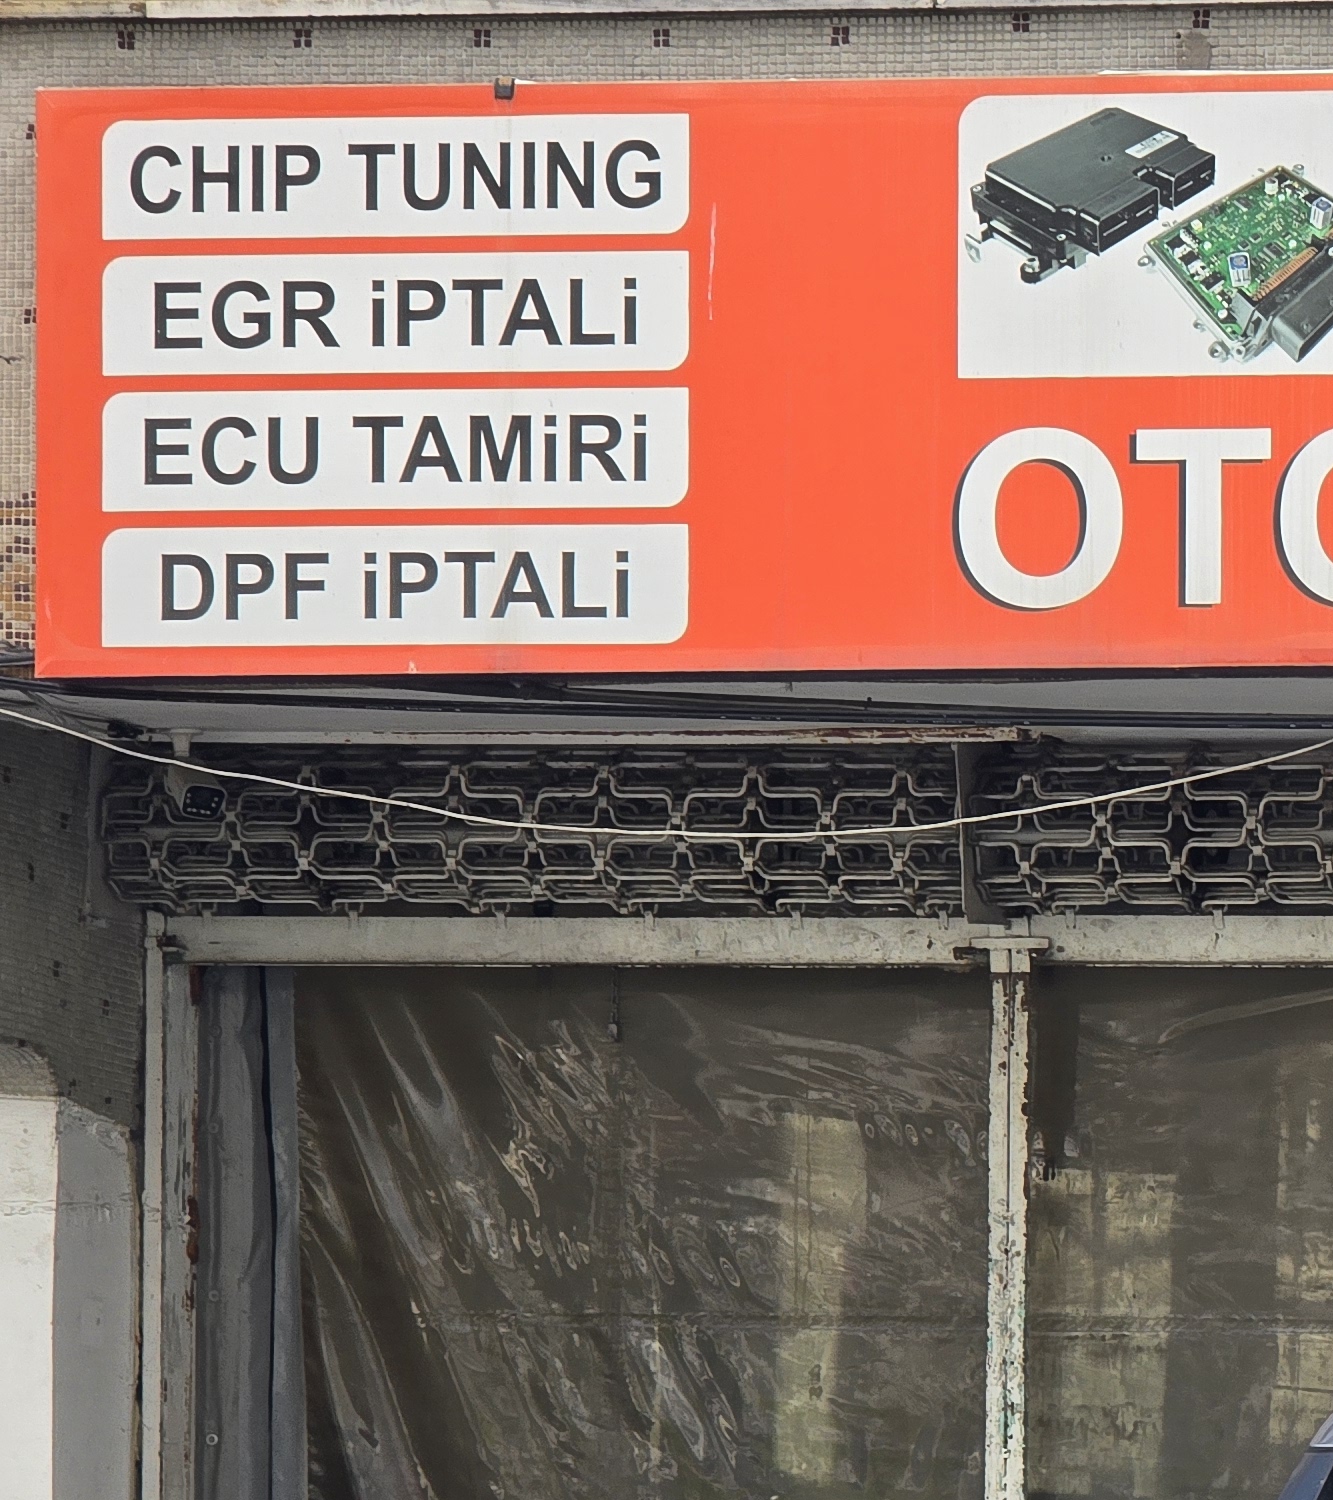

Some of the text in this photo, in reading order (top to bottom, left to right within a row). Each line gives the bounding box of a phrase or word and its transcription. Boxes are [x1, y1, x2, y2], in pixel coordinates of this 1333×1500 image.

[129, 139, 663, 214] CHIP TUNING
[152, 279, 341, 349] EGR
[143, 416, 320, 485] ECU
[160, 552, 330, 621] DPF
